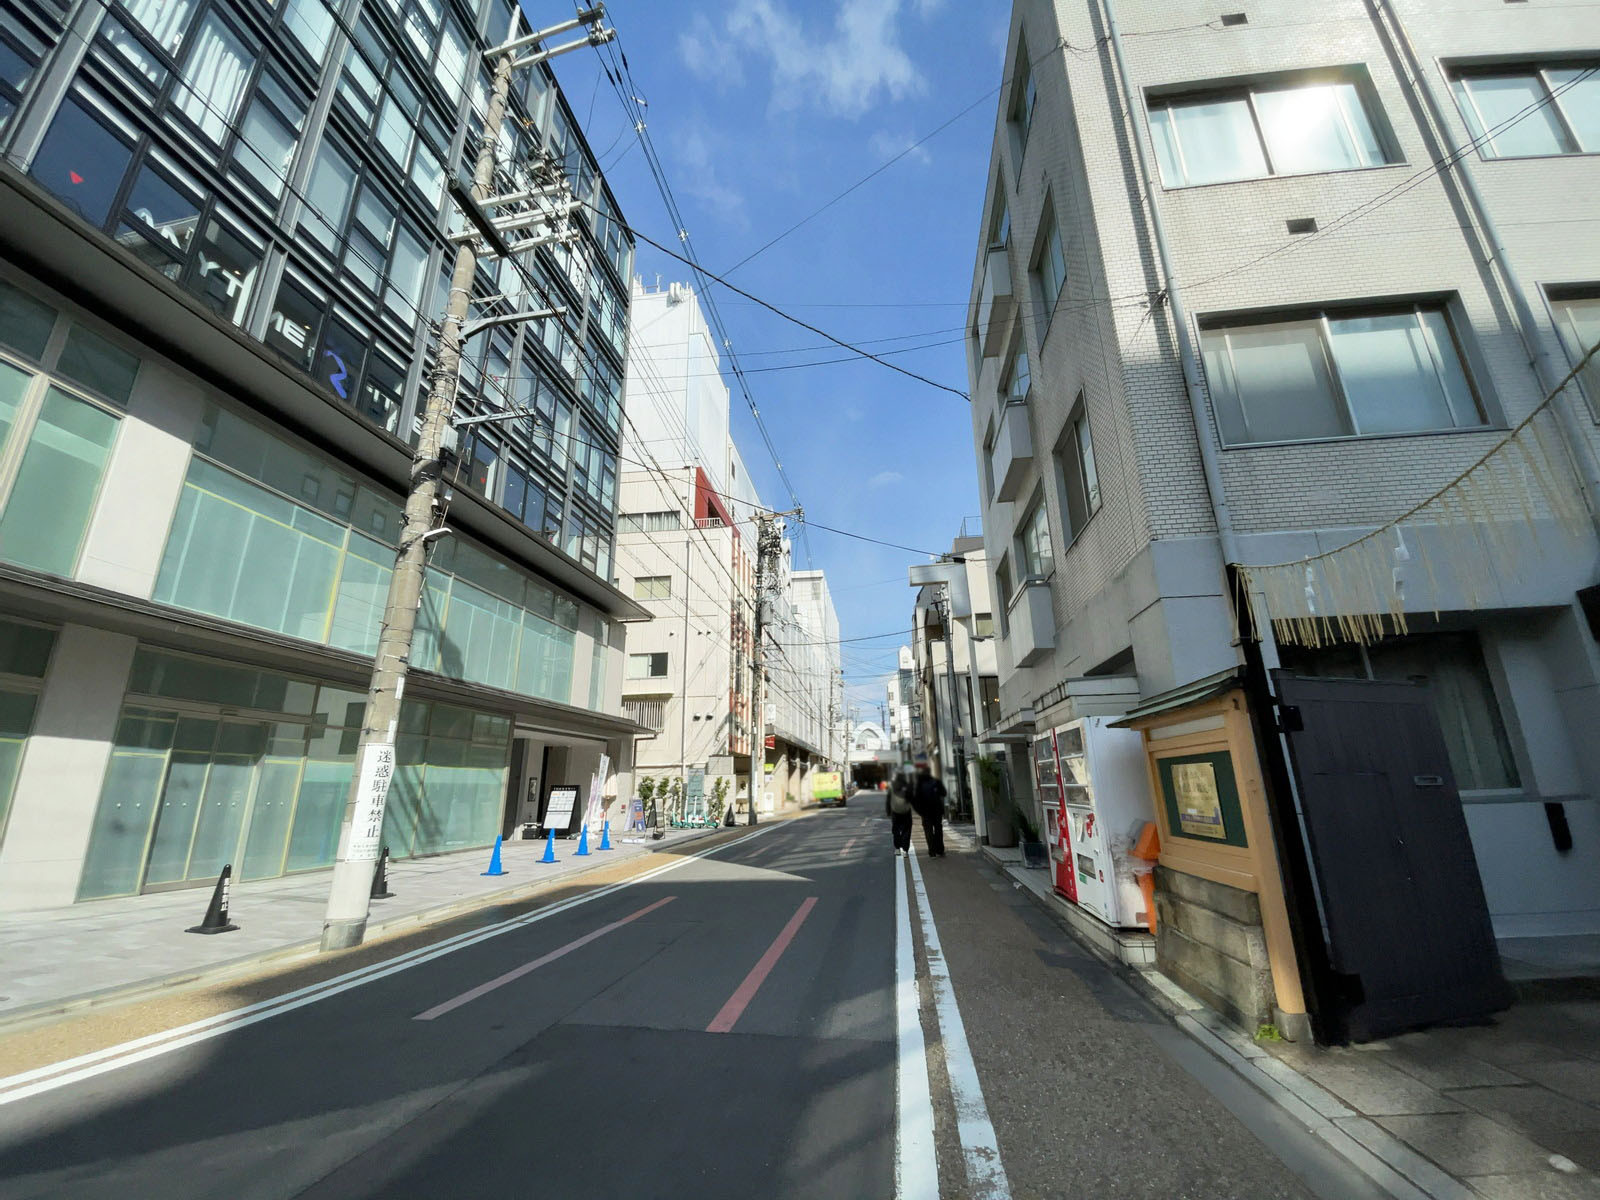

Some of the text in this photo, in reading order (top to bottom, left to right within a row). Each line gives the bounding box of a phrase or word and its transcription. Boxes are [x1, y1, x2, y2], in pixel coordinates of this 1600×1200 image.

[366, 749, 392, 838] 迷惑駐車禁止
